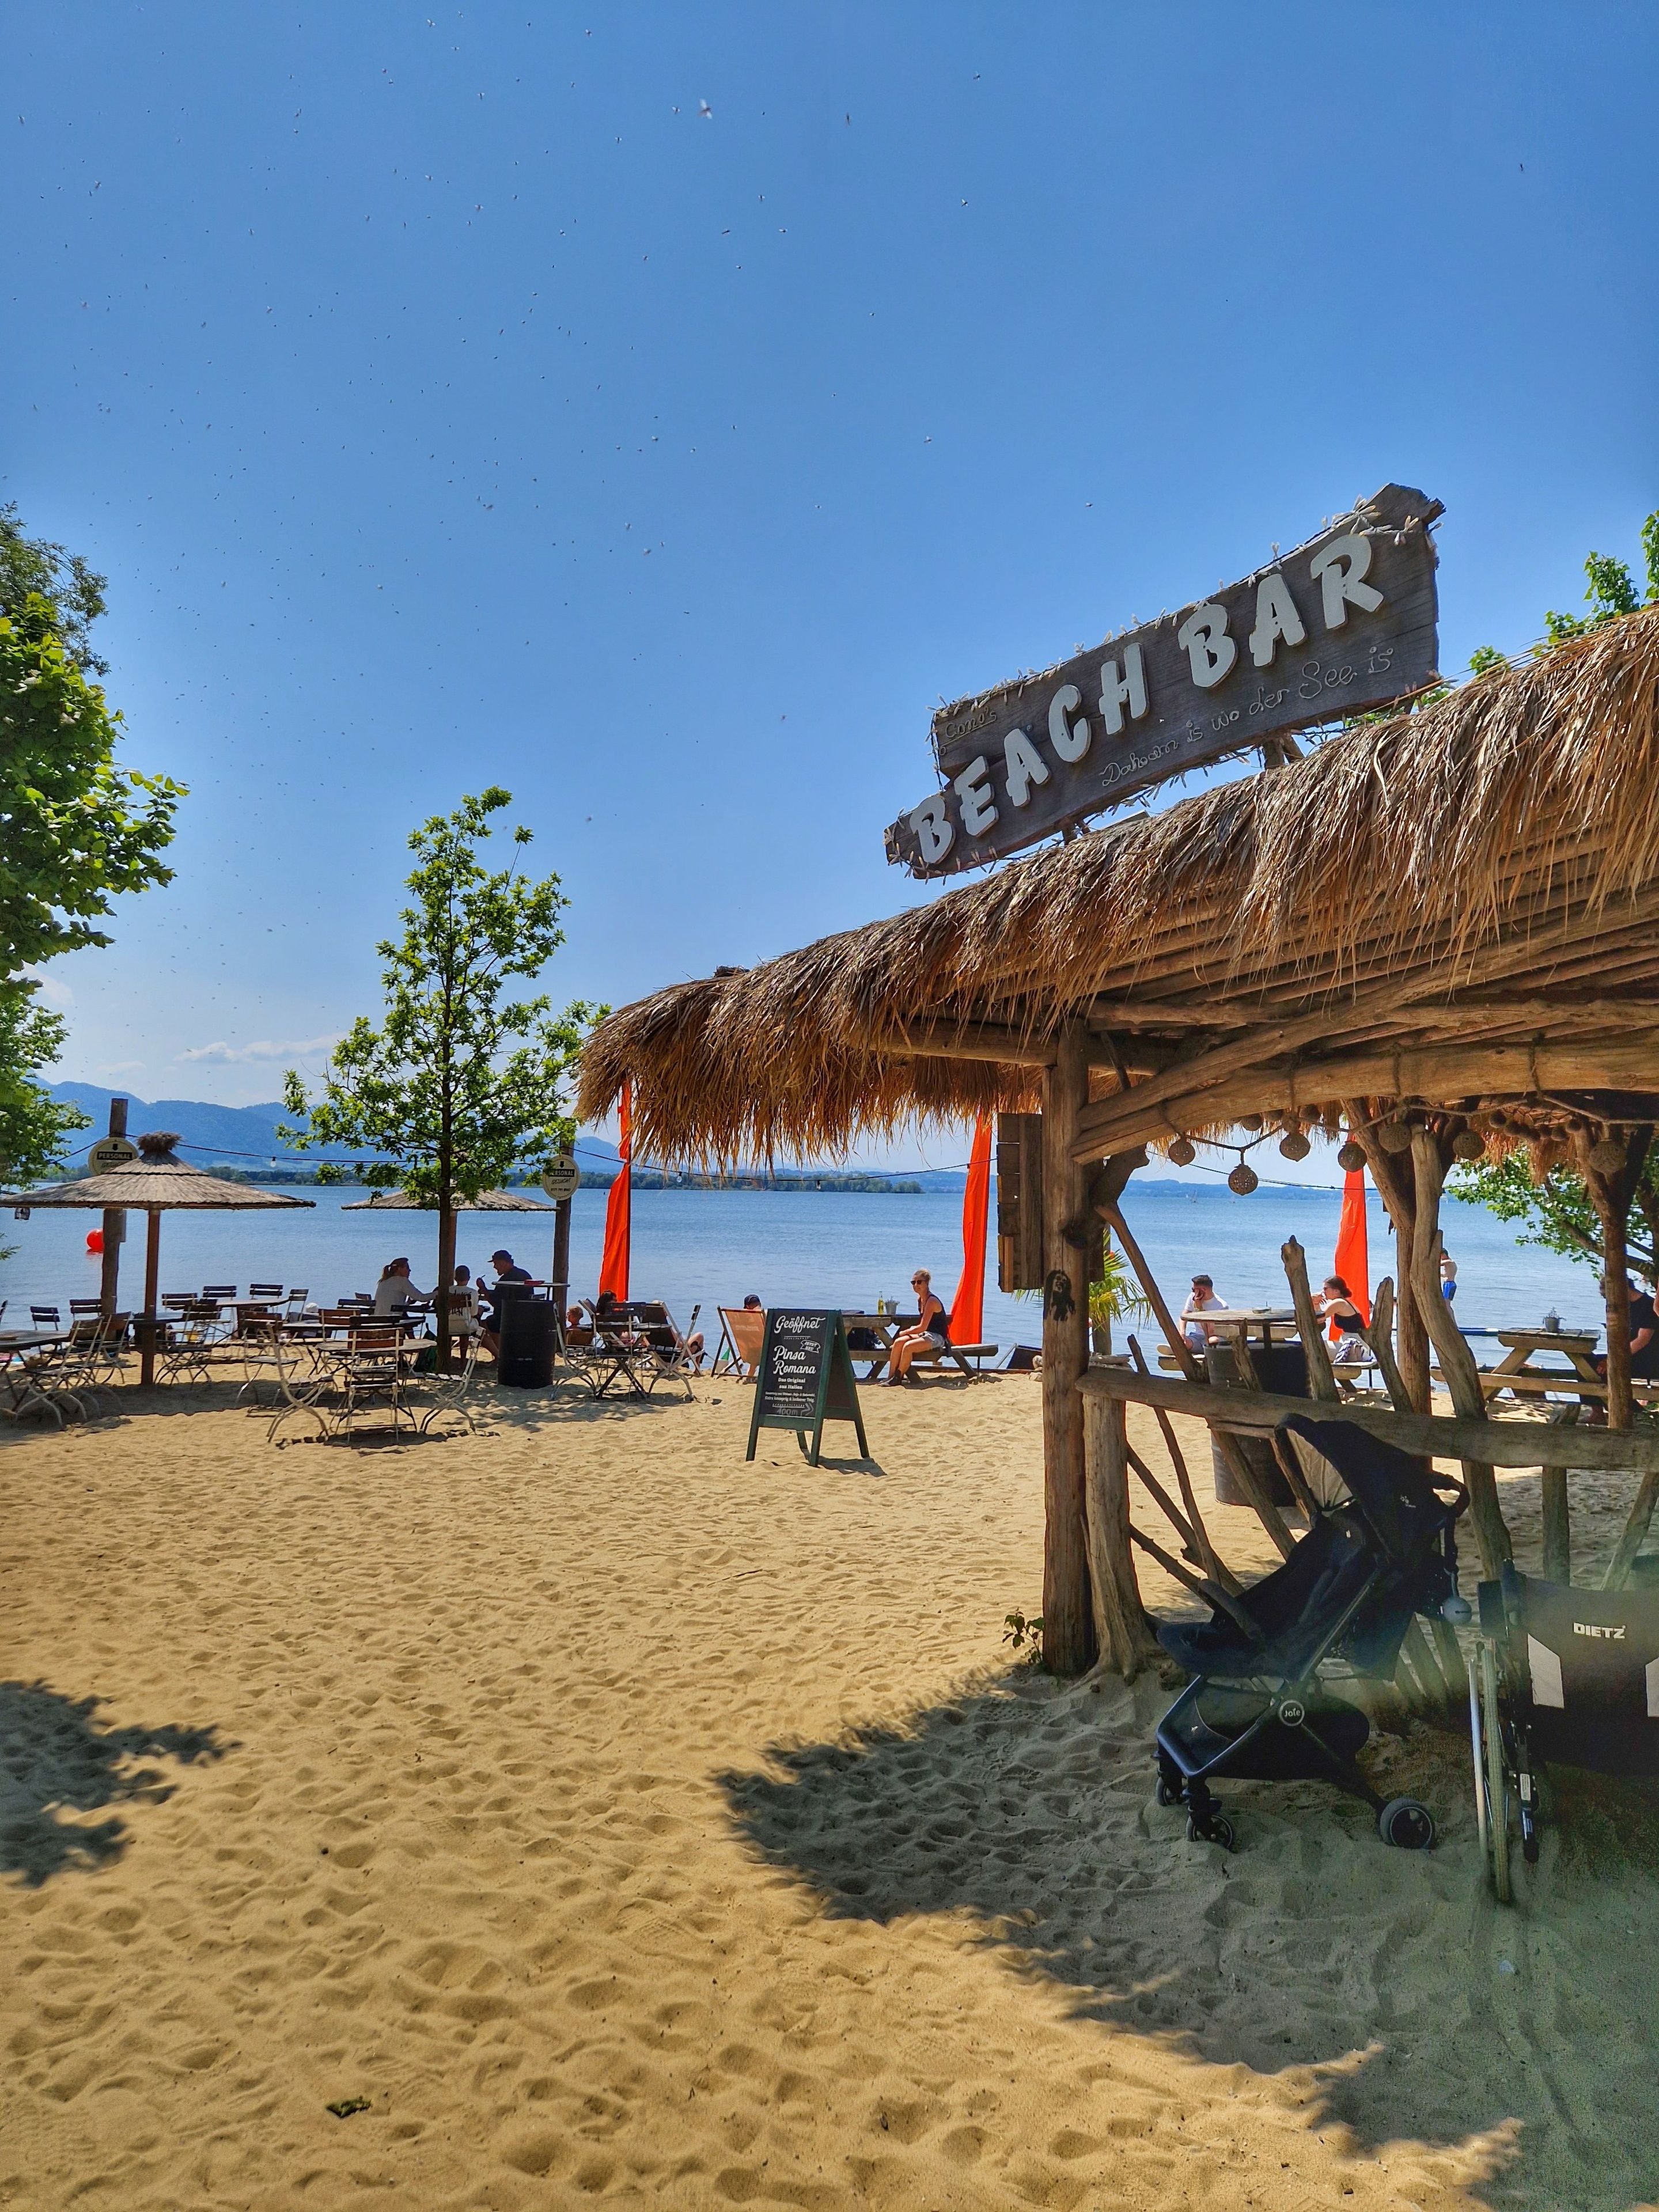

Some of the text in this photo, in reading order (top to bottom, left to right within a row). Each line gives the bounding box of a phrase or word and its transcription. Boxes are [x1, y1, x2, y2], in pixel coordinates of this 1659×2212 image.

[910, 533, 1384, 865] BEACH BAR
[1187, 720, 1203, 743] is
[1211, 710, 1240, 730] wo
[1249, 686, 1290, 715] der
[1298, 661, 1358, 699] See
[1368, 646, 1393, 674] is
[774, 1315, 826, 1334] Geöffnet
[773, 1345, 806, 1361] Pinsa
[773, 1360, 816, 1376] Romana
[1573, 1622, 1626, 1639] DIETZ
[1285, 1707, 1301, 1717] Joie
